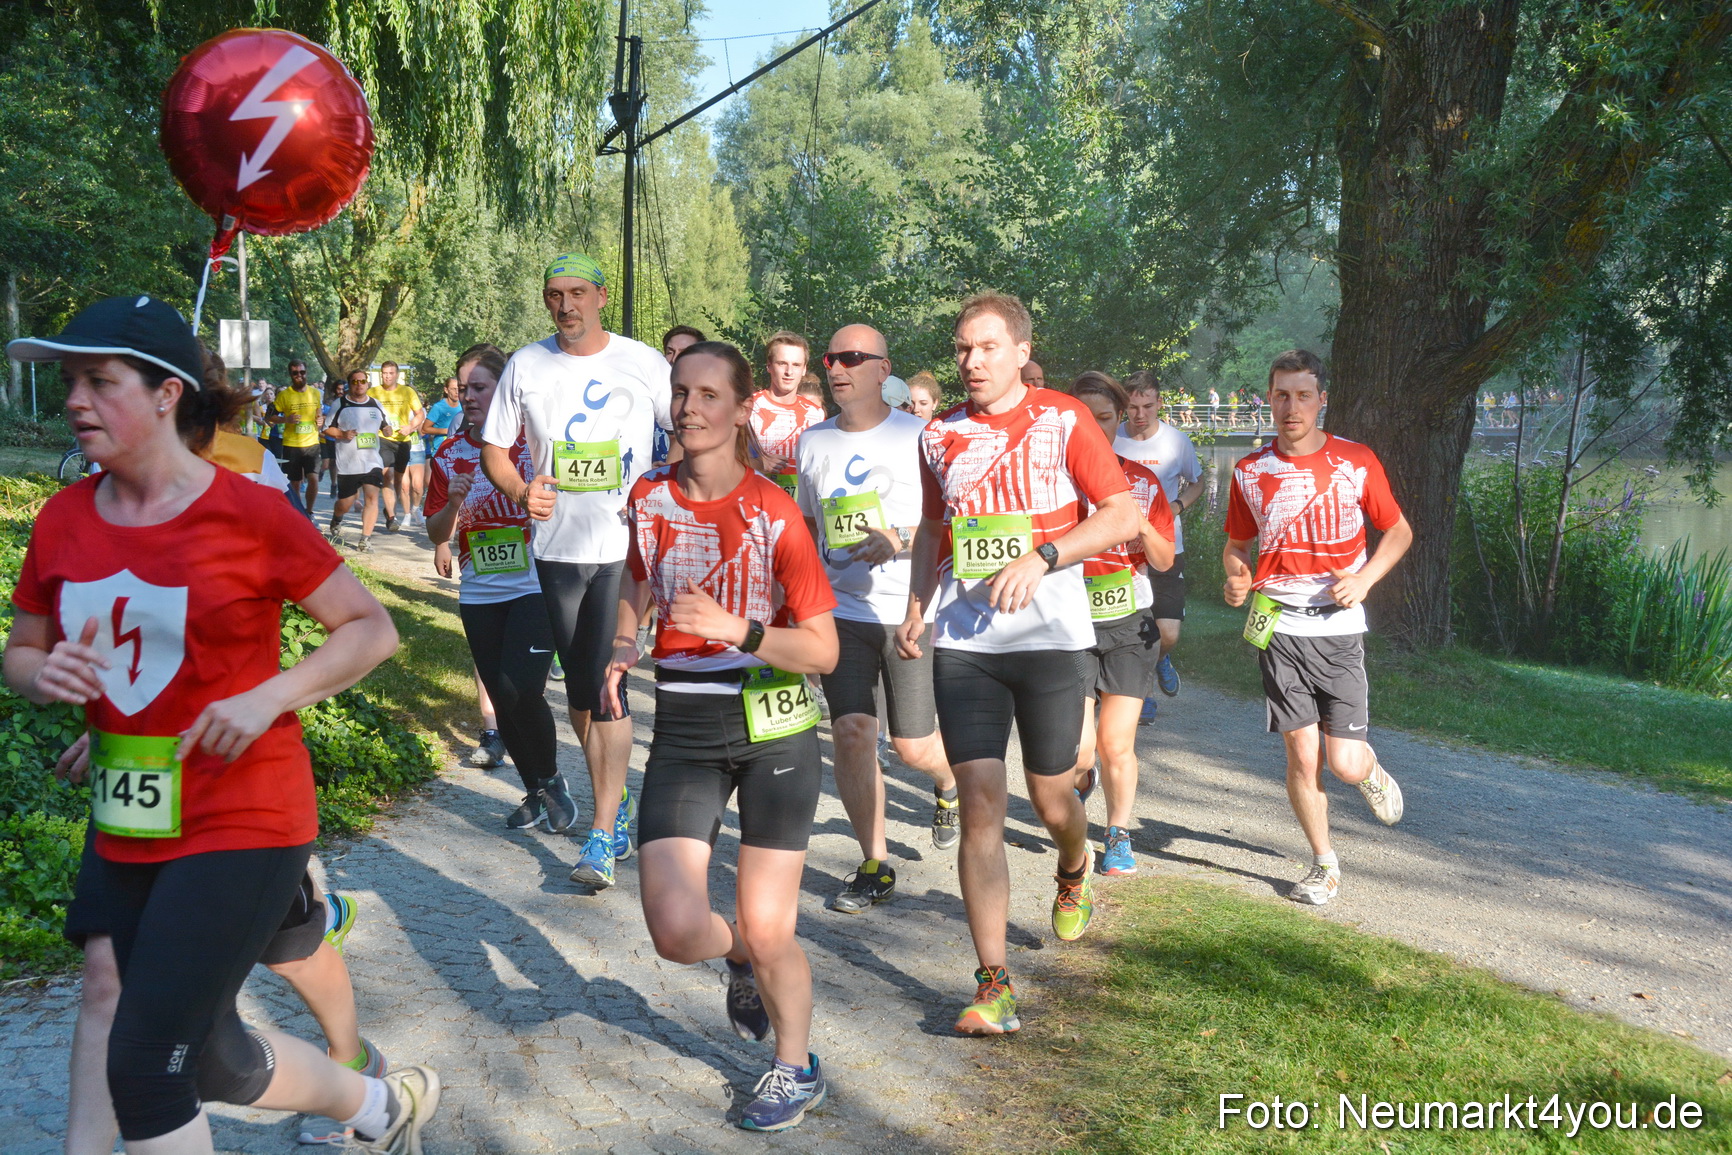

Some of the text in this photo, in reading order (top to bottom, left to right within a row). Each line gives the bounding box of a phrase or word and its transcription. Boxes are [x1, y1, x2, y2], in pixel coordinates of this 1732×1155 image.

[568, 459, 606, 477] 474
[834, 512, 868, 533] 473
[478, 543, 517, 562] 1857
[963, 537, 1021, 560] 1836
[770, 716, 792, 726] Luber
[167, 1044, 186, 1073] GORE
